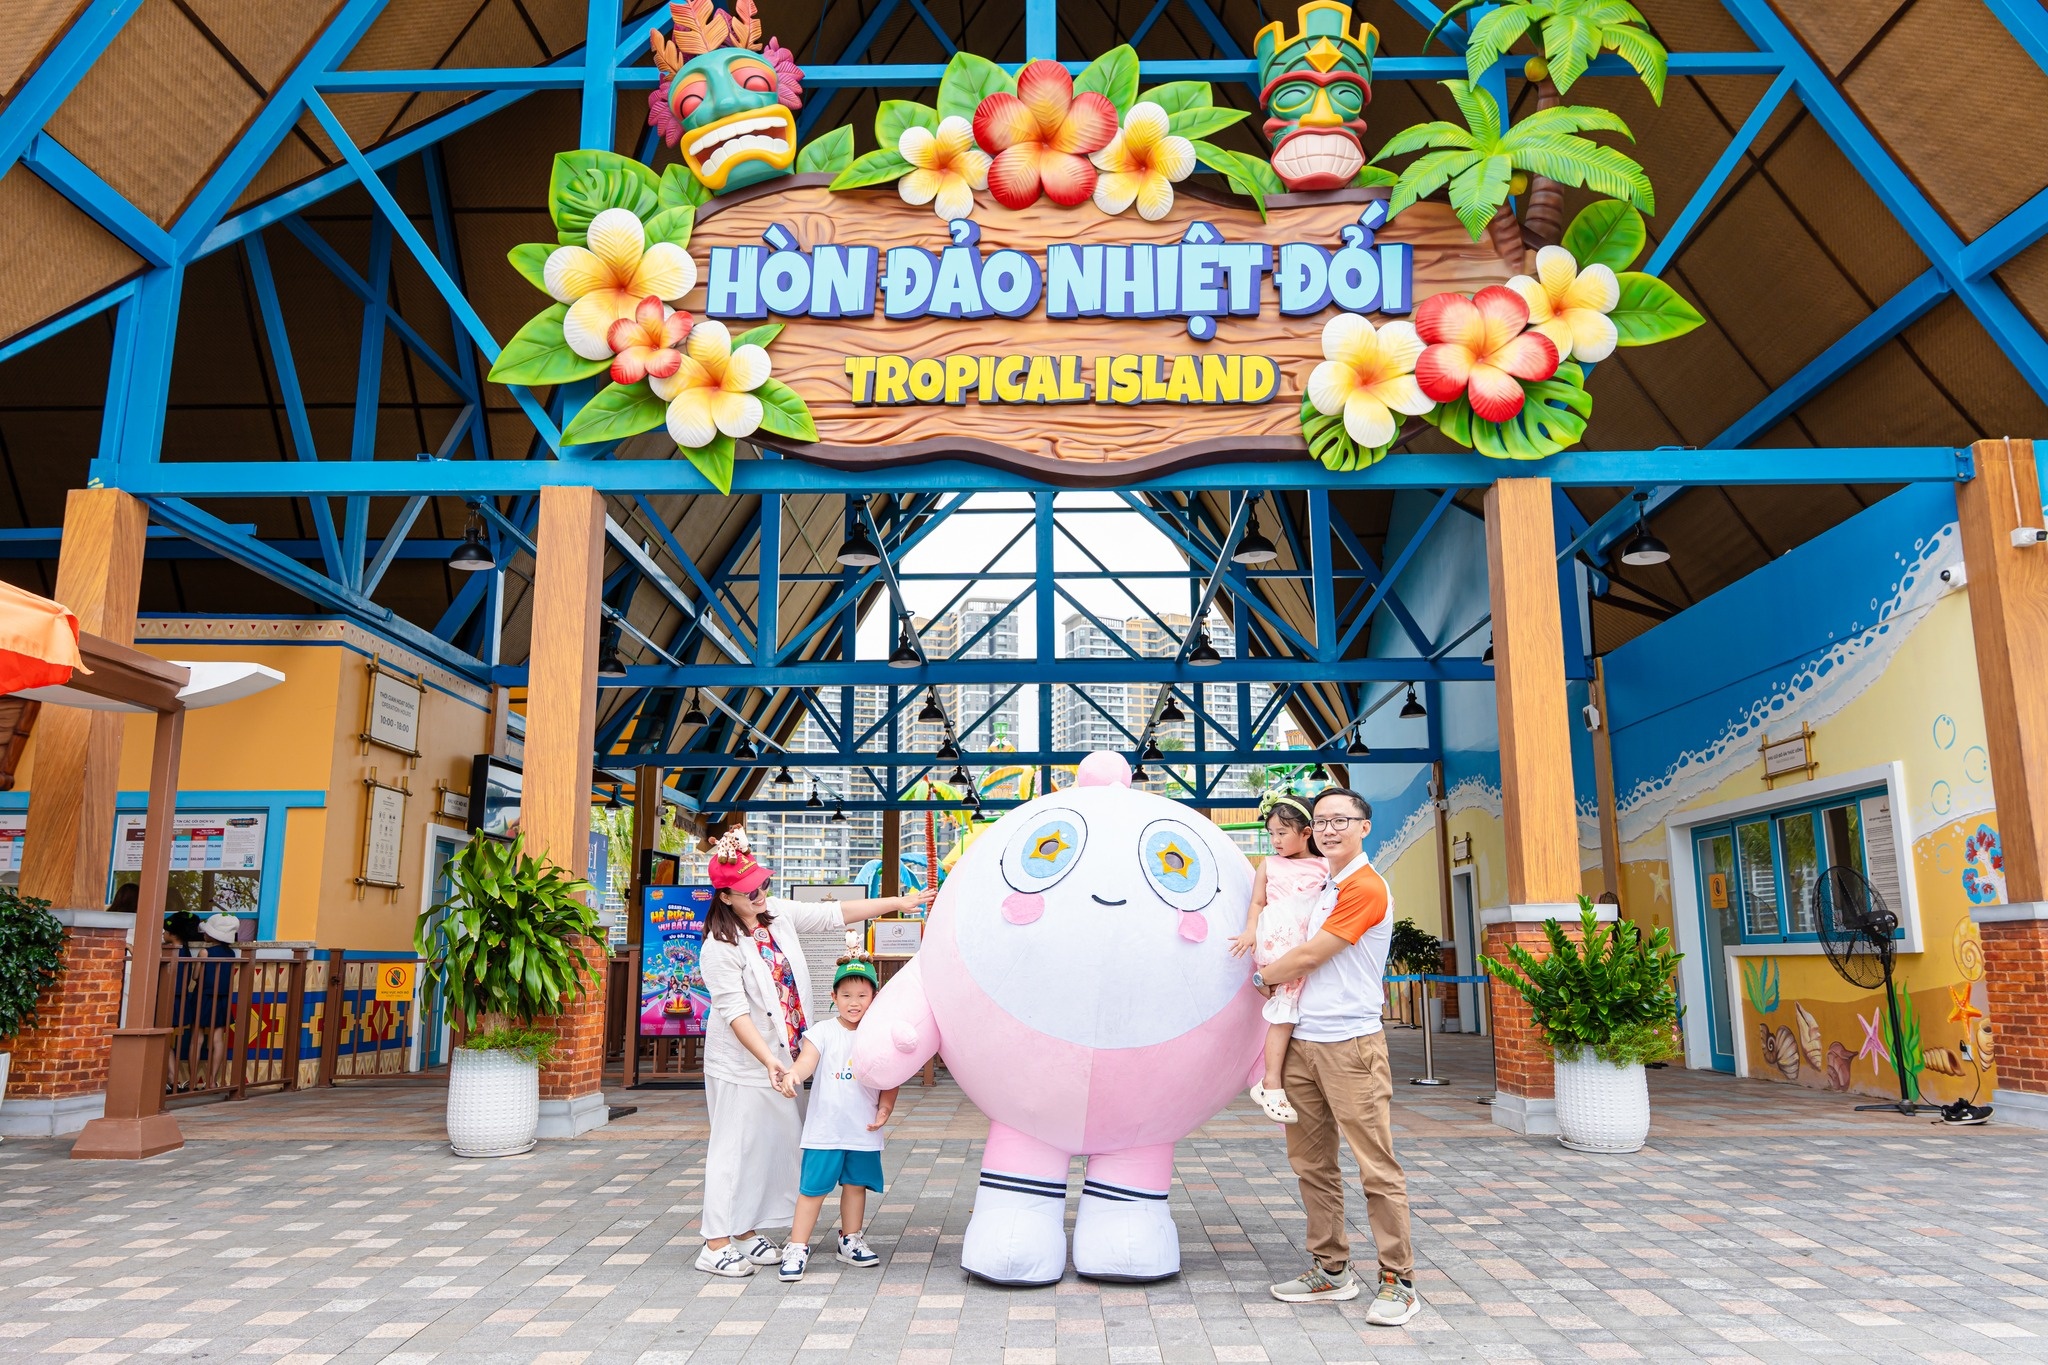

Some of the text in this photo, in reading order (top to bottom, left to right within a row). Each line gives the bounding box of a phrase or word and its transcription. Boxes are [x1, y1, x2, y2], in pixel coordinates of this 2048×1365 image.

[705, 222, 879, 320] HÒN
[880, 218, 1043, 319] ĐẢO
[1045, 221, 1273, 342] NHIỆT
[845, 354, 1281, 407] TROPICAL ISLAND
[380, 715, 394, 727] 10:00
[650, 908, 666, 923] HÈ
